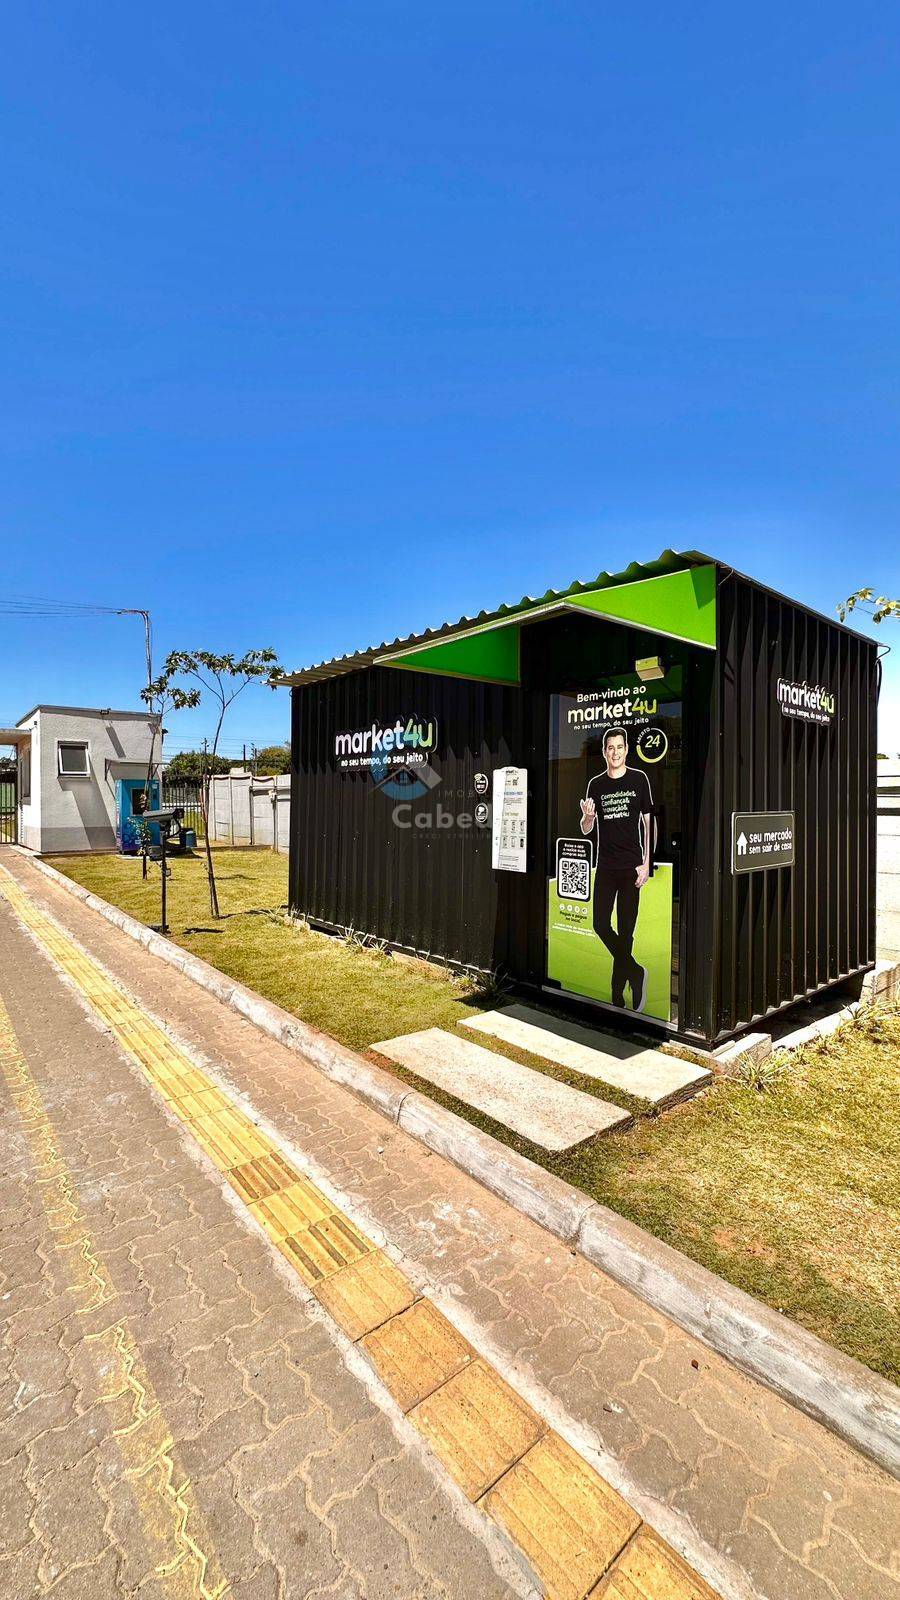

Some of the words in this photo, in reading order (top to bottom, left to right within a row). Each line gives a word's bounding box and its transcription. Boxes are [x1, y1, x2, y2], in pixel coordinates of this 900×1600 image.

[576, 686, 631, 703] Bem-vindo
[632, 685, 647, 695] ao
[779, 683, 835, 714] market4u
[567, 697, 657, 724] market4u
[592, 721, 612, 729] tempo,
[613, 719, 622, 727] do
[633, 717, 650, 726] jeito
[335, 718, 433, 756] market4u
[645, 734, 660, 748] 24
[341, 759, 349, 767] no
[349, 758, 359, 766] seu
[383, 755, 392, 764] do
[392, 754, 405, 763] seu
[405, 752, 424, 765] jeito
[749, 833, 762, 843] seu
[763, 827, 793, 842] mercado
[749, 846, 761, 855] sem
[762, 842, 773, 853] sair
[773, 841, 781, 852] de
[781, 842, 792, 851] casa
